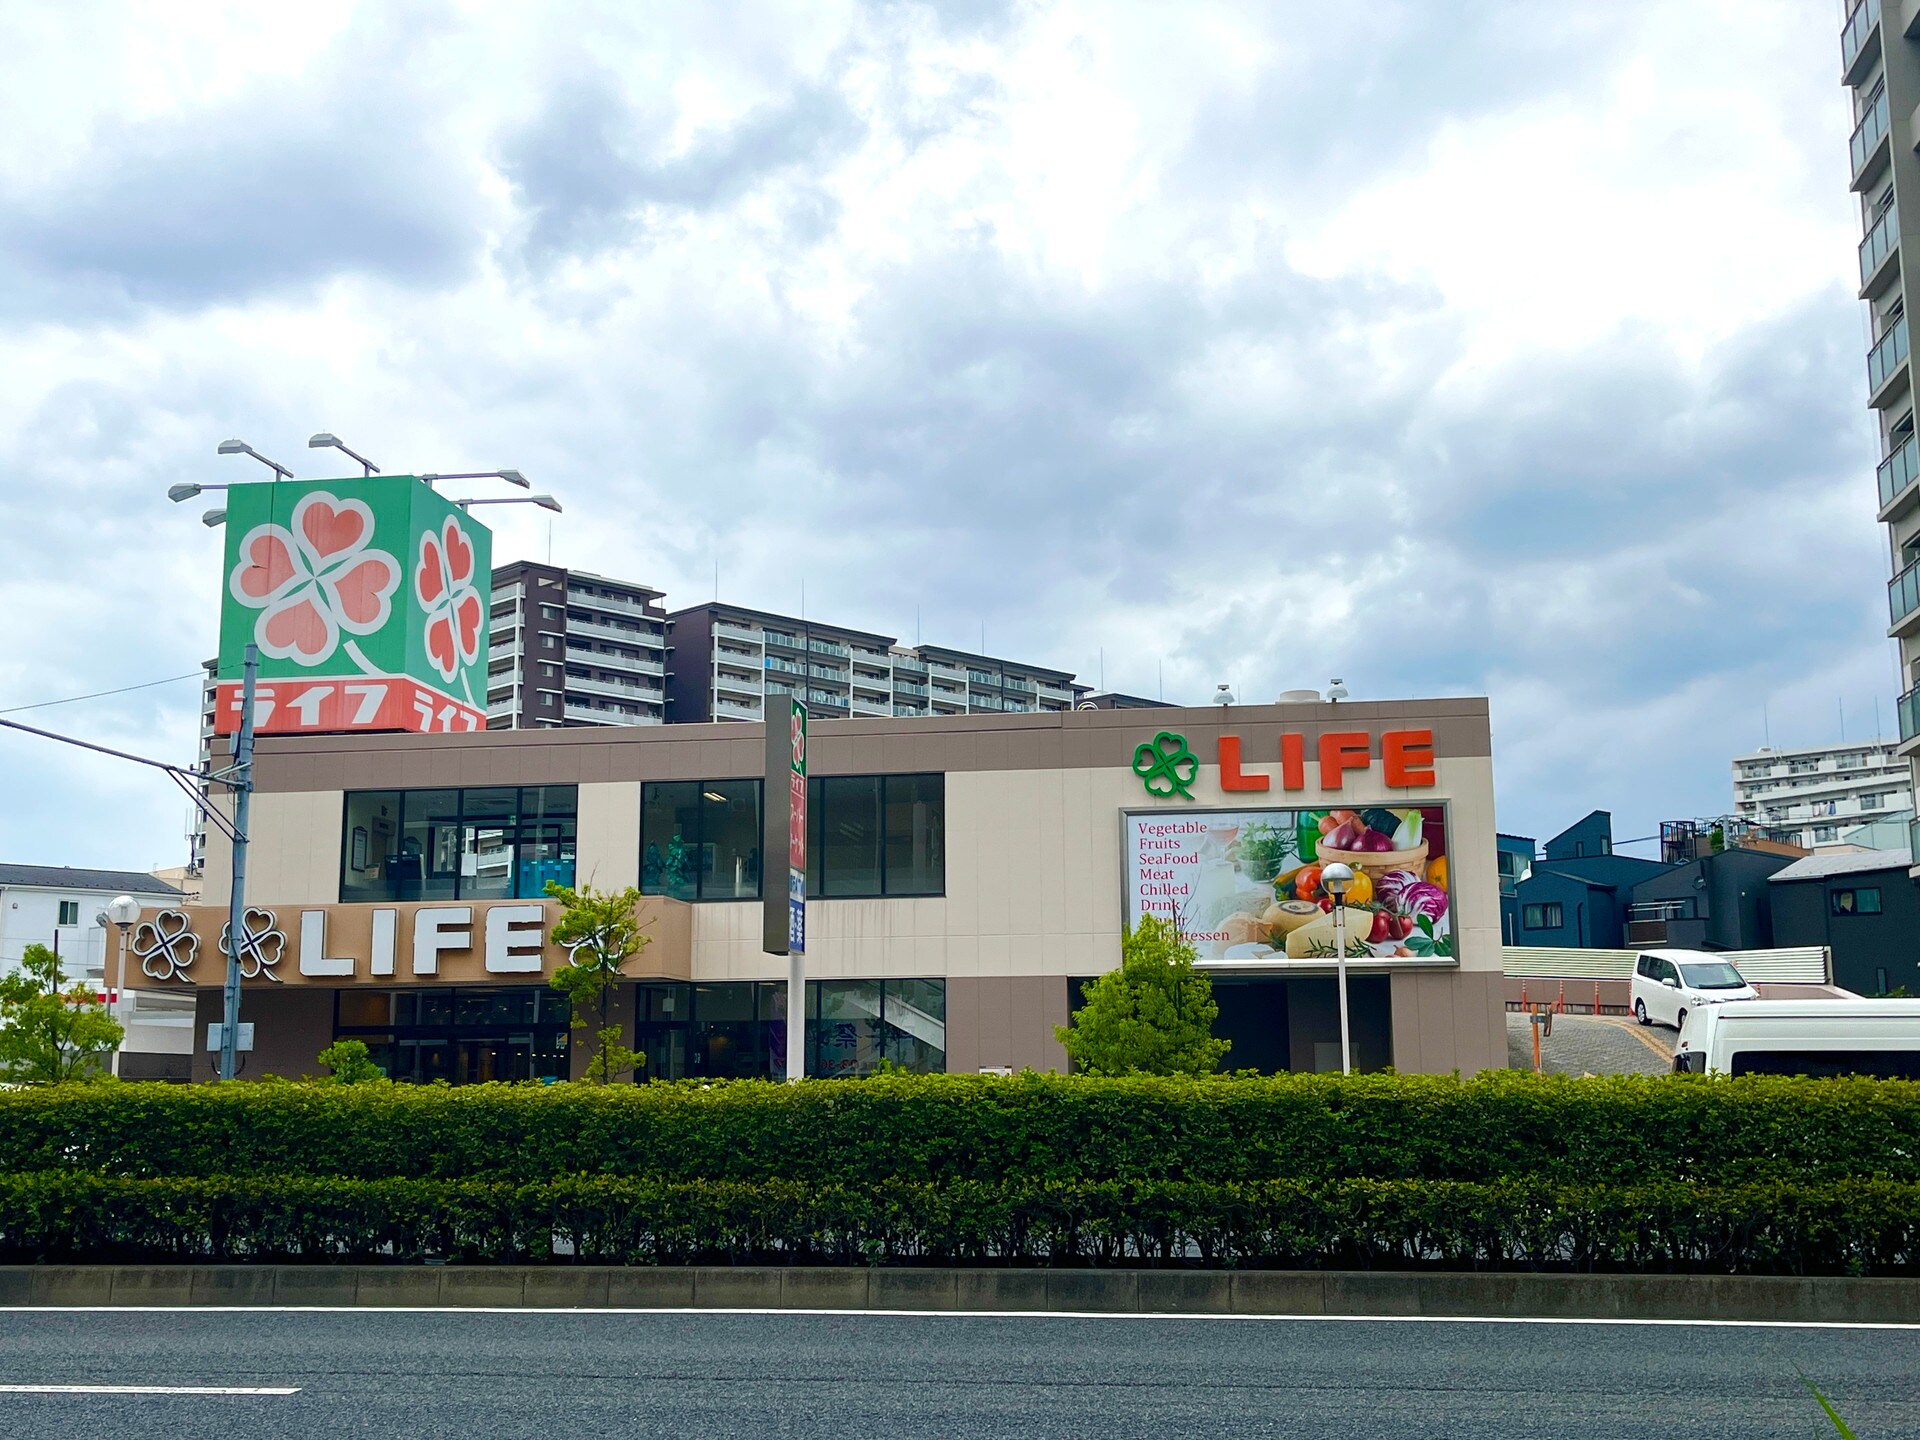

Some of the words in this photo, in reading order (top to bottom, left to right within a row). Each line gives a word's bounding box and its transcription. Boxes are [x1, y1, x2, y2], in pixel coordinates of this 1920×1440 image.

[230, 684, 389, 728] ライフ
[413, 689, 478, 733] ライフ
[1218, 729, 1436, 792] LIFE
[1138, 821, 1207, 837] Vegetable
[1140, 838, 1181, 850] Fruits
[1139, 852, 1199, 865] SeaFood
[1140, 868, 1174, 881] Meat
[1140, 883, 1188, 896] Chilled
[1141, 899, 1181, 911] Drink
[299, 905, 546, 977] LIFE
